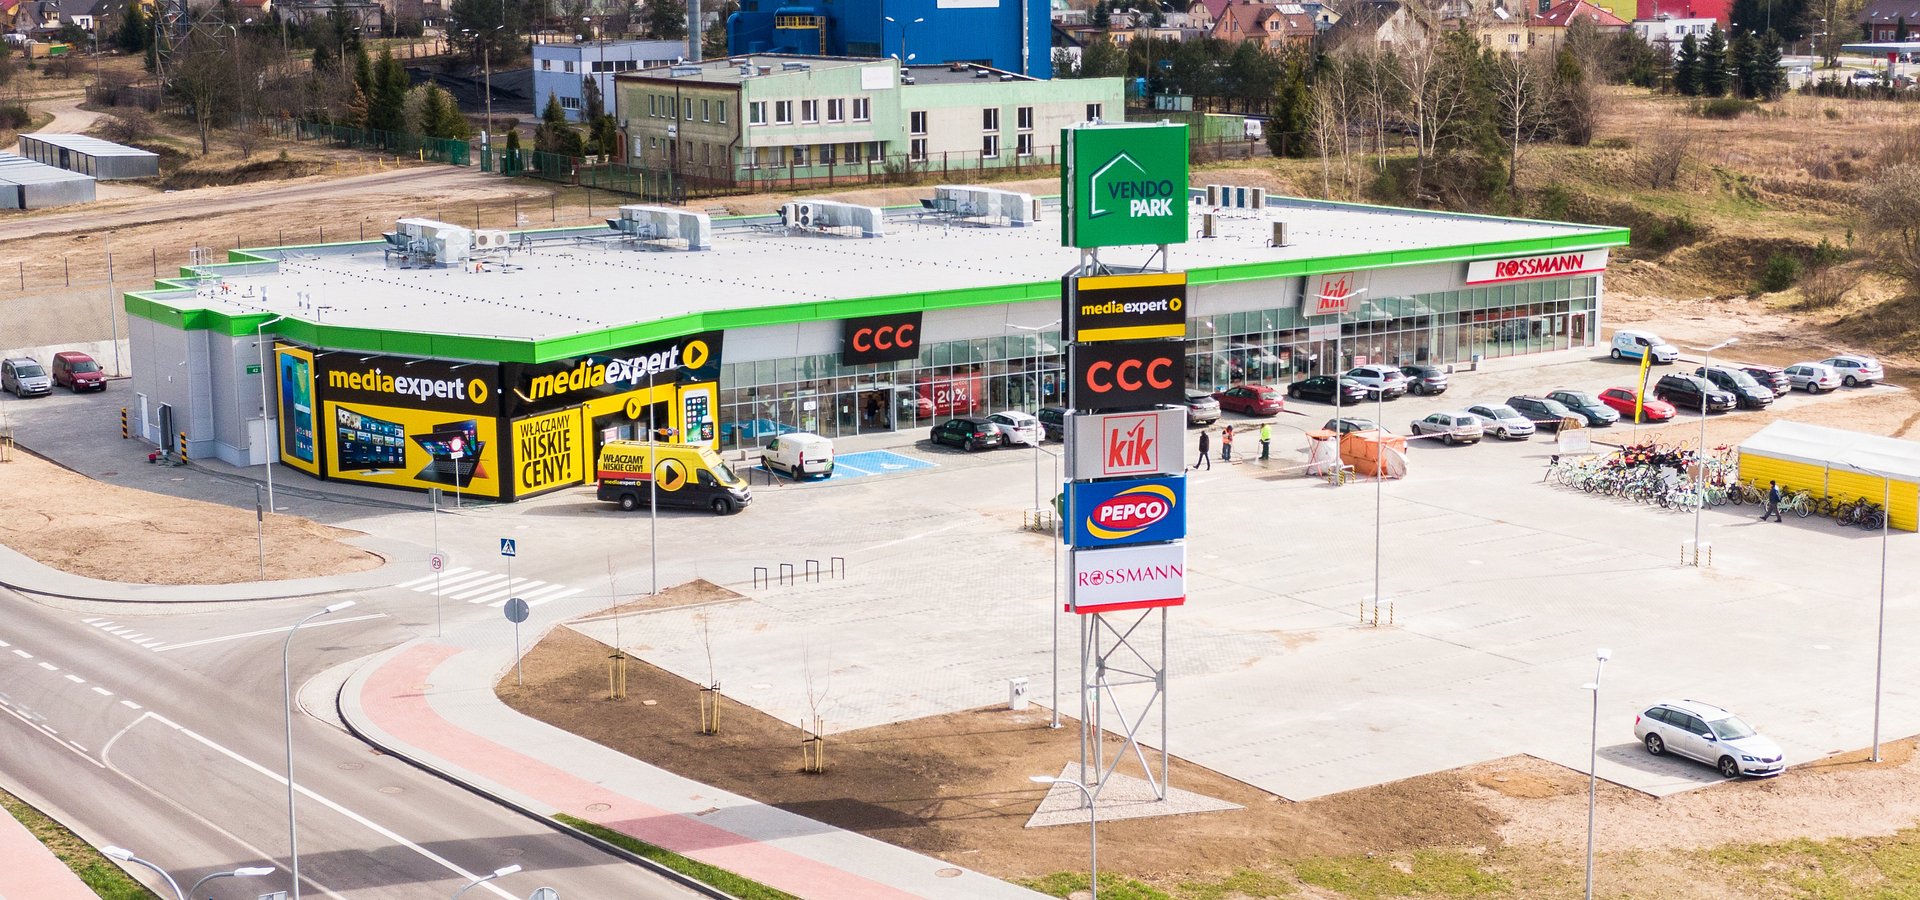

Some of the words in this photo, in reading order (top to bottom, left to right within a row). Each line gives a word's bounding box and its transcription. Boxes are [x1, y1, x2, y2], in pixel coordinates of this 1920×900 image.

[1108, 179, 1174, 199] VENDO
[1130, 198, 1173, 218] PARK
[1495, 254, 1584, 277] ROSSMANN
[1320, 276, 1349, 309] kik
[1082, 299, 1168, 316] mediaexpert
[852, 323, 915, 352] CCC
[329, 367, 465, 401] mediaexpert
[529, 345, 680, 400] mediaexpert
[1086, 357, 1173, 393] CCC
[521, 428, 571, 462] NISKIE
[1108, 419, 1154, 468] kik
[522, 452, 572, 489] CENY!
[603, 462, 624, 471] NISKIE
[625, 464, 643, 473] CENY!
[1100, 501, 1163, 522] PEPCO
[1079, 563, 1183, 588] ROSSMANN
